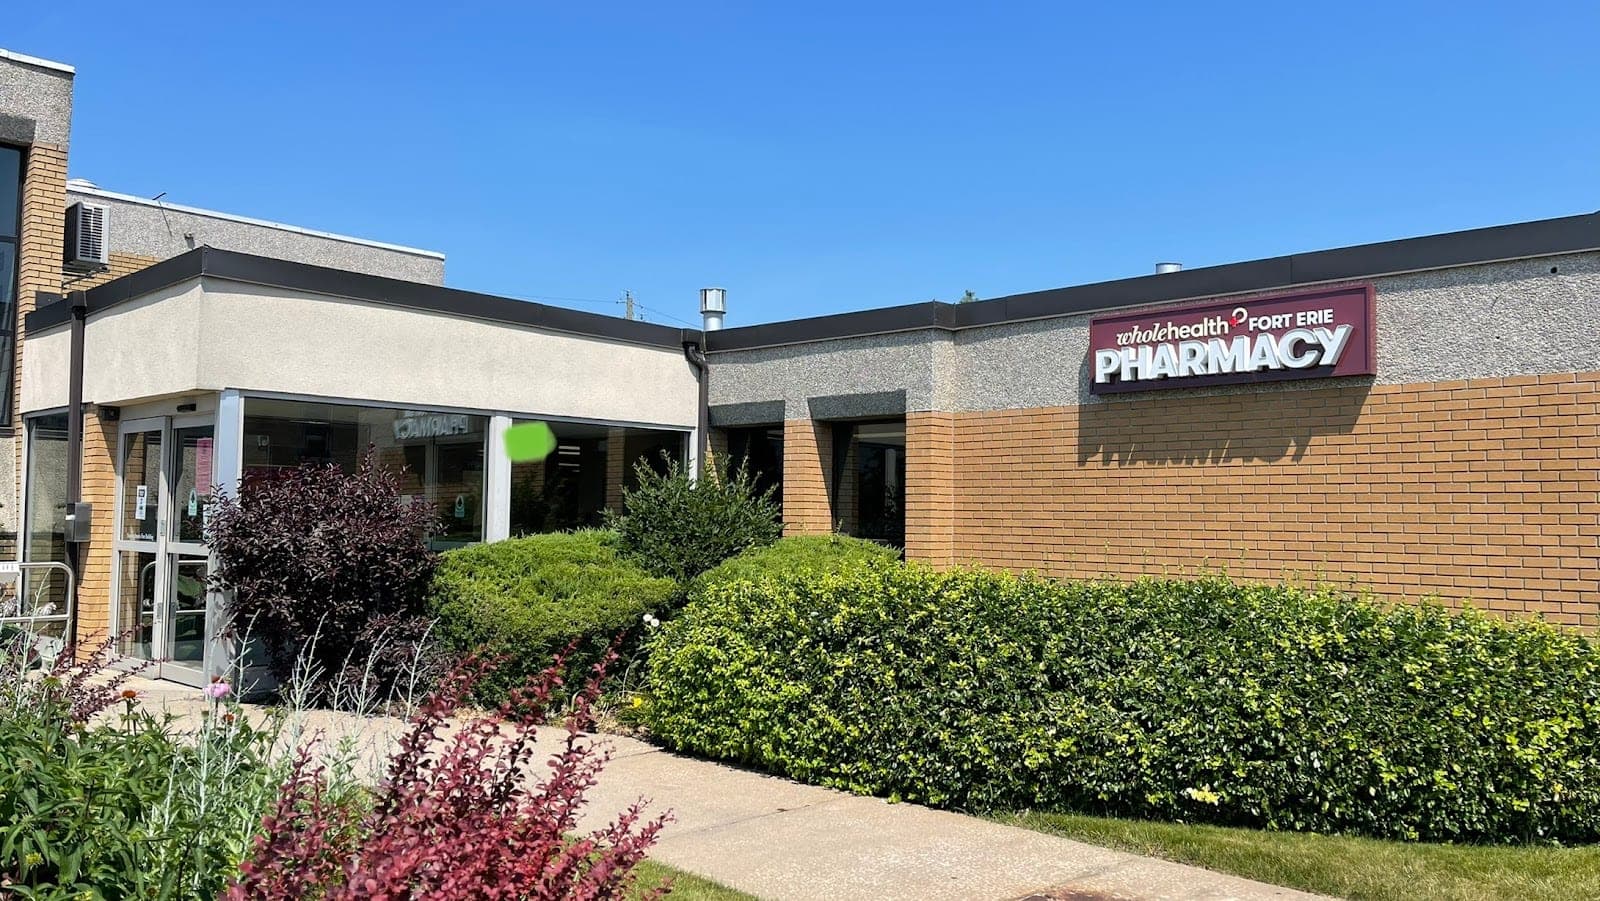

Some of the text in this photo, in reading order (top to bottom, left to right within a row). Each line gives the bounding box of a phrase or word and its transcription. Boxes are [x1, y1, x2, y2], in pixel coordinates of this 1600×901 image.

[1116, 308, 1334, 346] wholehealth FORT ERIE
[1095, 324, 1353, 384] PHARMACY
